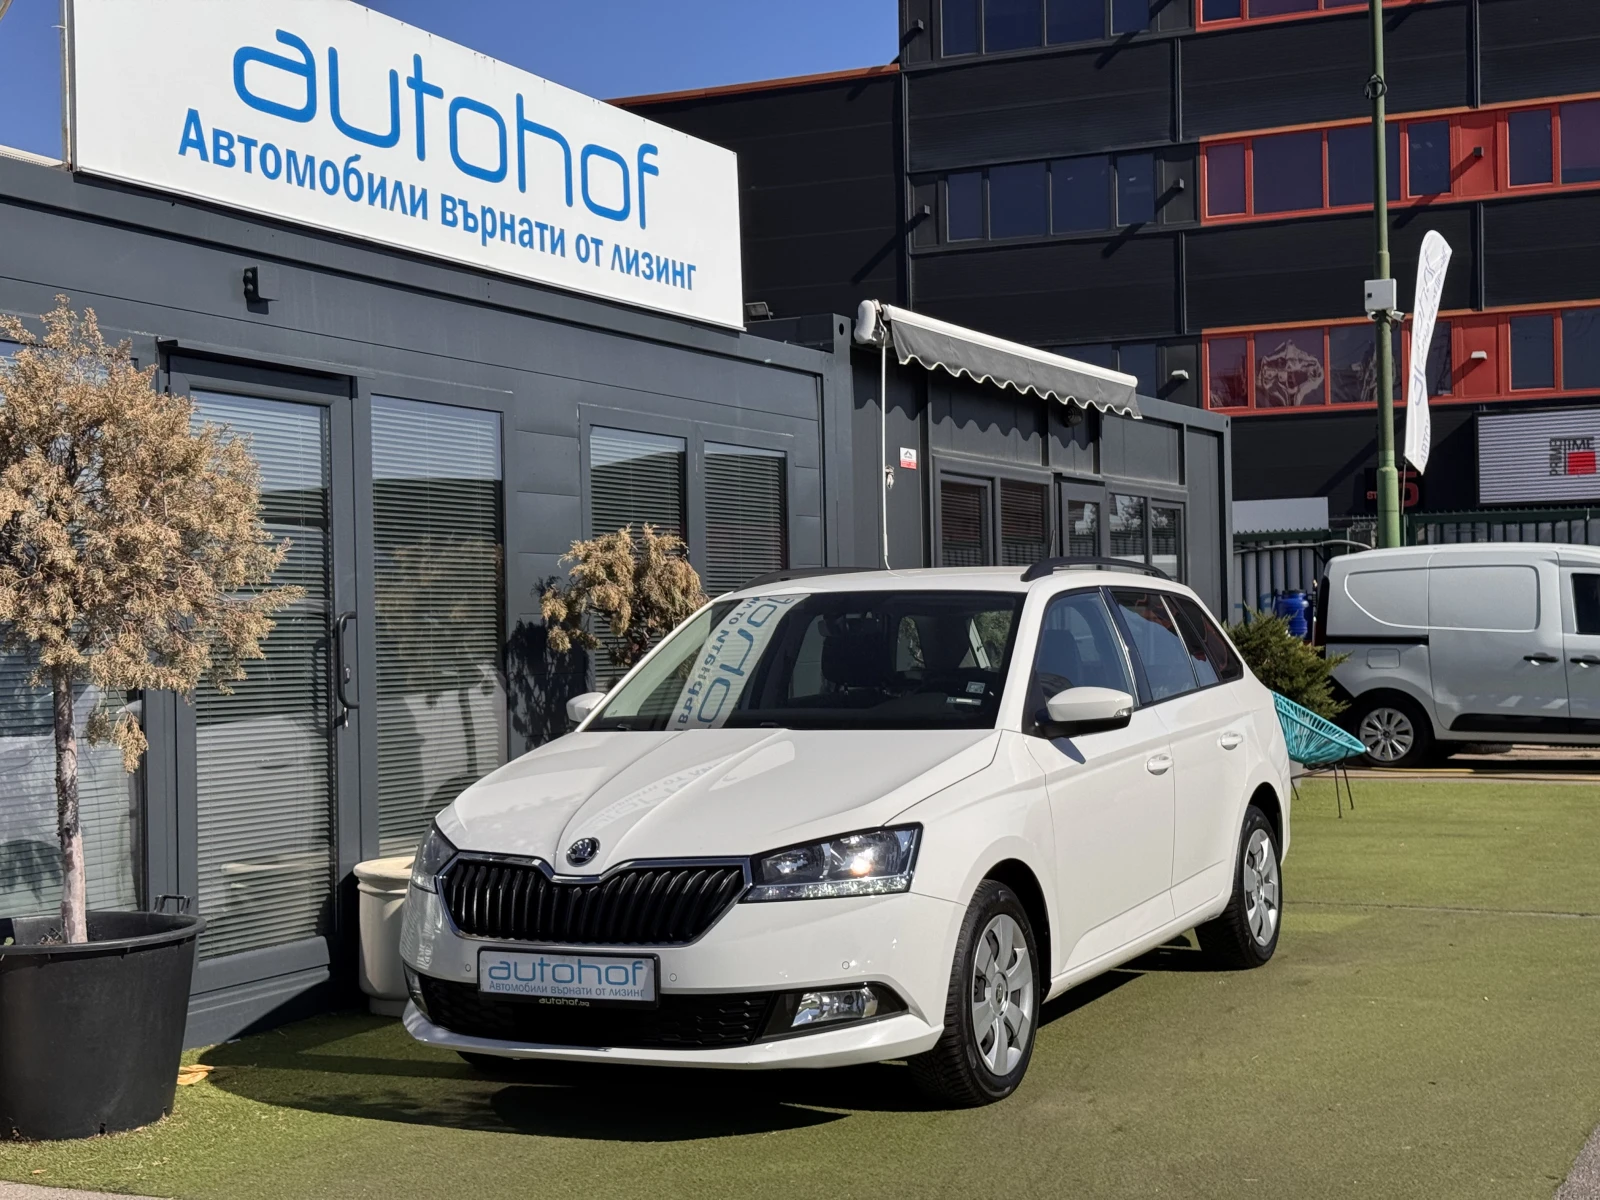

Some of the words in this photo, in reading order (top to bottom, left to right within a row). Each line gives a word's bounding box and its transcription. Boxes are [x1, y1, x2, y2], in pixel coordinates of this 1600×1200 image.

[233, 28, 659, 230] autohof
[178, 107, 428, 221] Автомобили
[440, 193, 566, 259] върнати
[575, 233, 604, 267] от
[611, 243, 697, 291] лизинг
[488, 957, 643, 986] autohof
[489, 980, 548, 994] Автомобили
[550, 985, 593, 996] върнати
[595, 988, 606, 997] от
[608, 988, 645, 998] лизинг
